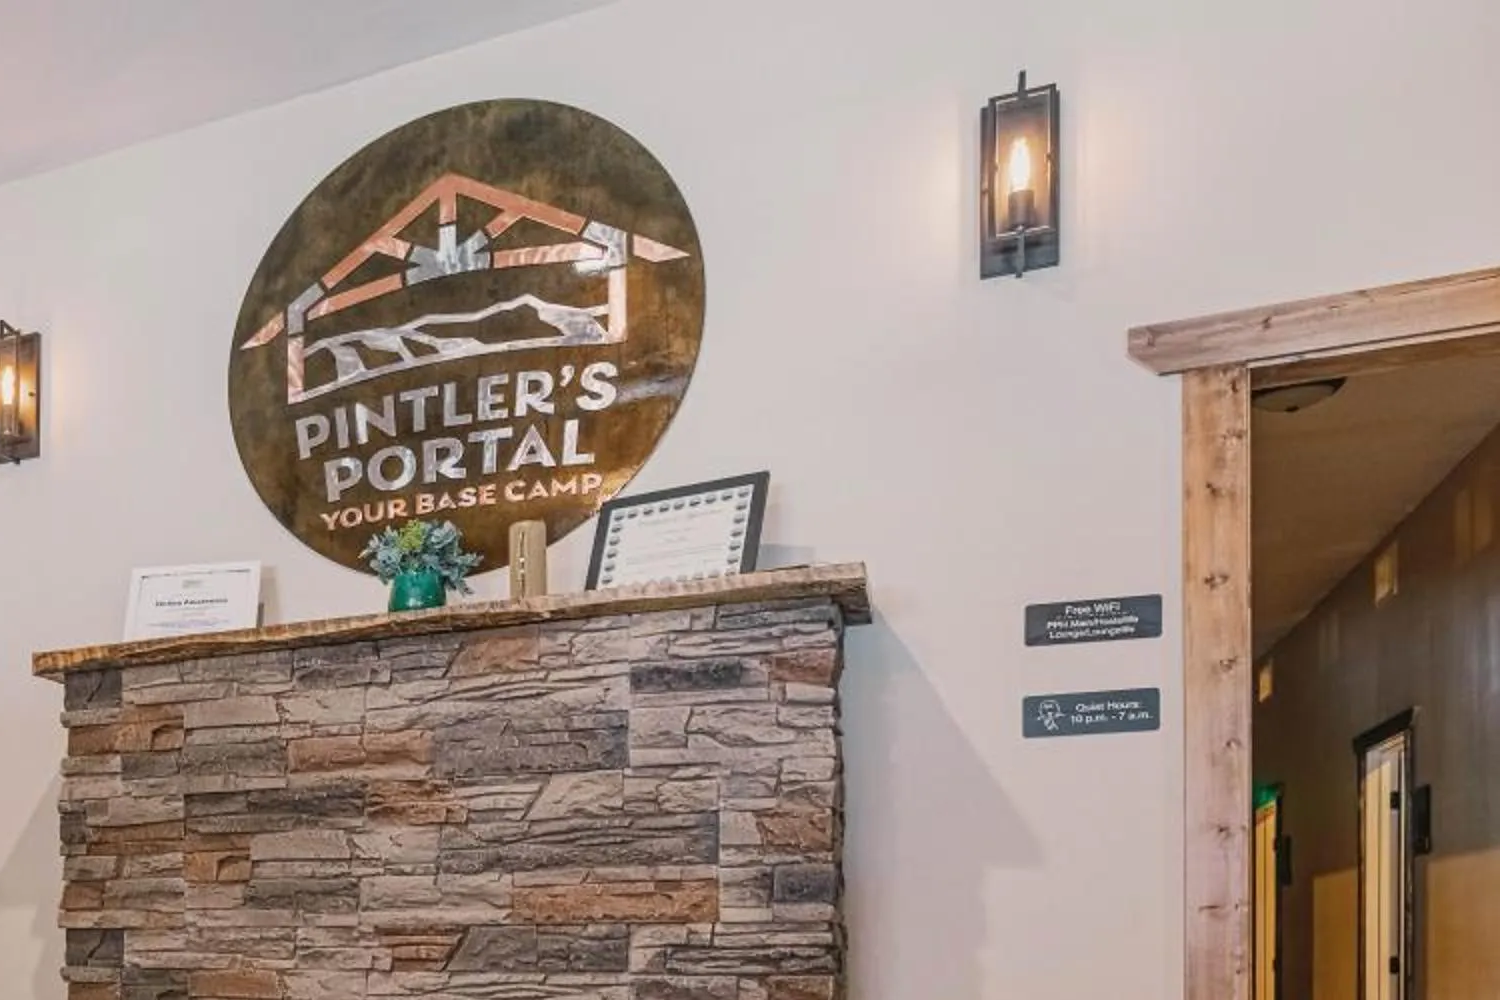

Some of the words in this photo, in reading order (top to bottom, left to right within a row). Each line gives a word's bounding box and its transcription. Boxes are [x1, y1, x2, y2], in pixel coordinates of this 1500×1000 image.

[295, 361, 620, 460] PINTLER'S
[323, 418, 596, 503] PORTAL
[321, 498, 408, 532] YOUR
[415, 483, 497, 515] BASE
[504, 472, 602, 502] CAMP
[1071, 714, 1083, 725] 10
[1075, 702, 1105, 712] Quiet
